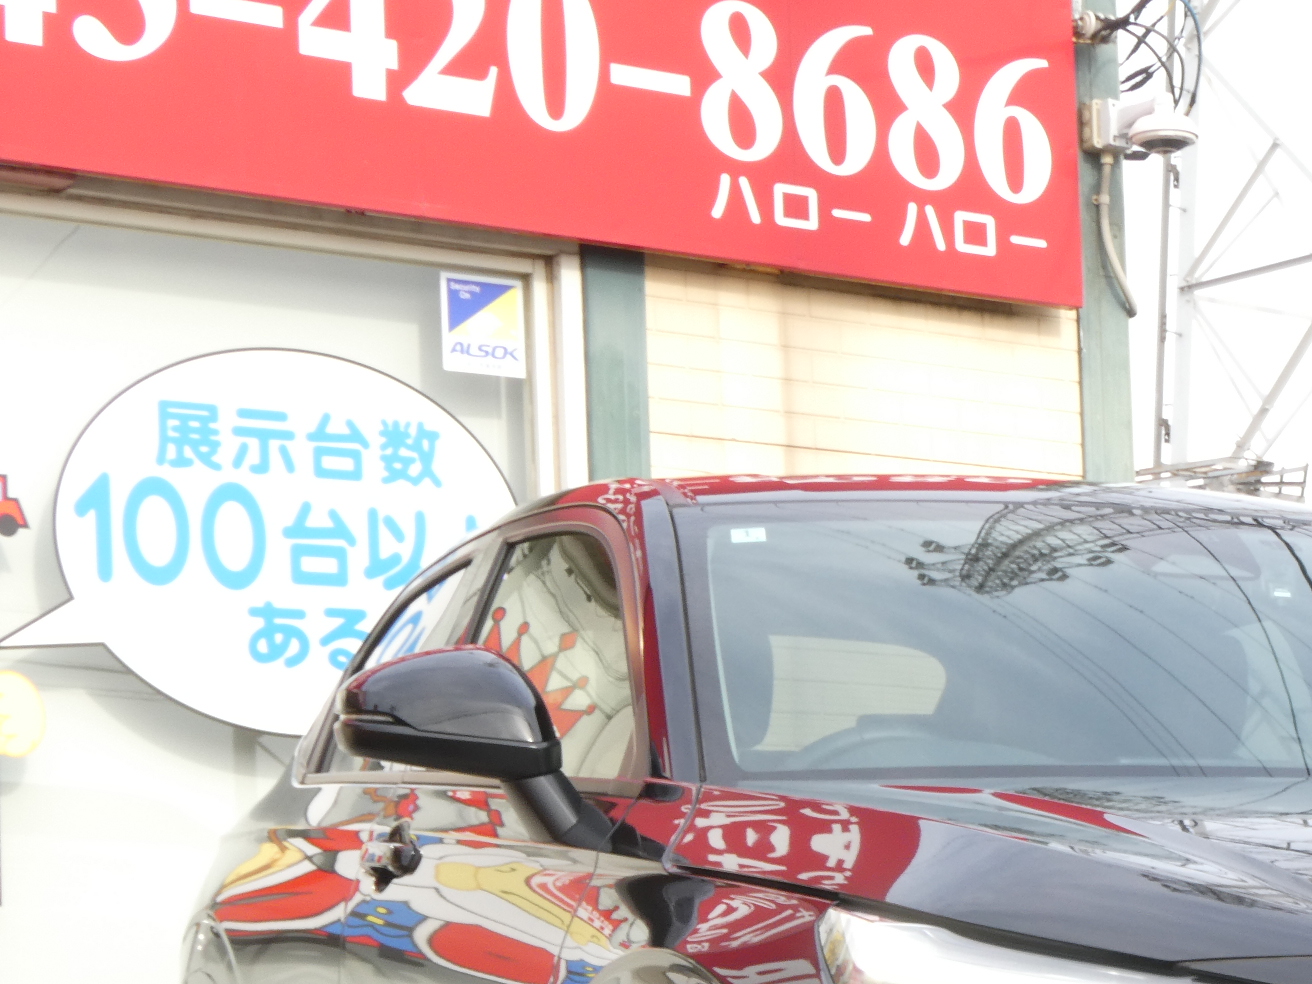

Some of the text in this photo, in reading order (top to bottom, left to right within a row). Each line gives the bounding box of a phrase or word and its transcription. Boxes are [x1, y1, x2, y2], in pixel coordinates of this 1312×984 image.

[711, 173, 1048, 257] ハロー ハロー
[450, 341, 519, 362] ALSOK
[155, 400, 442, 488] 展示台数
[73, 472, 478, 591] 100台以
